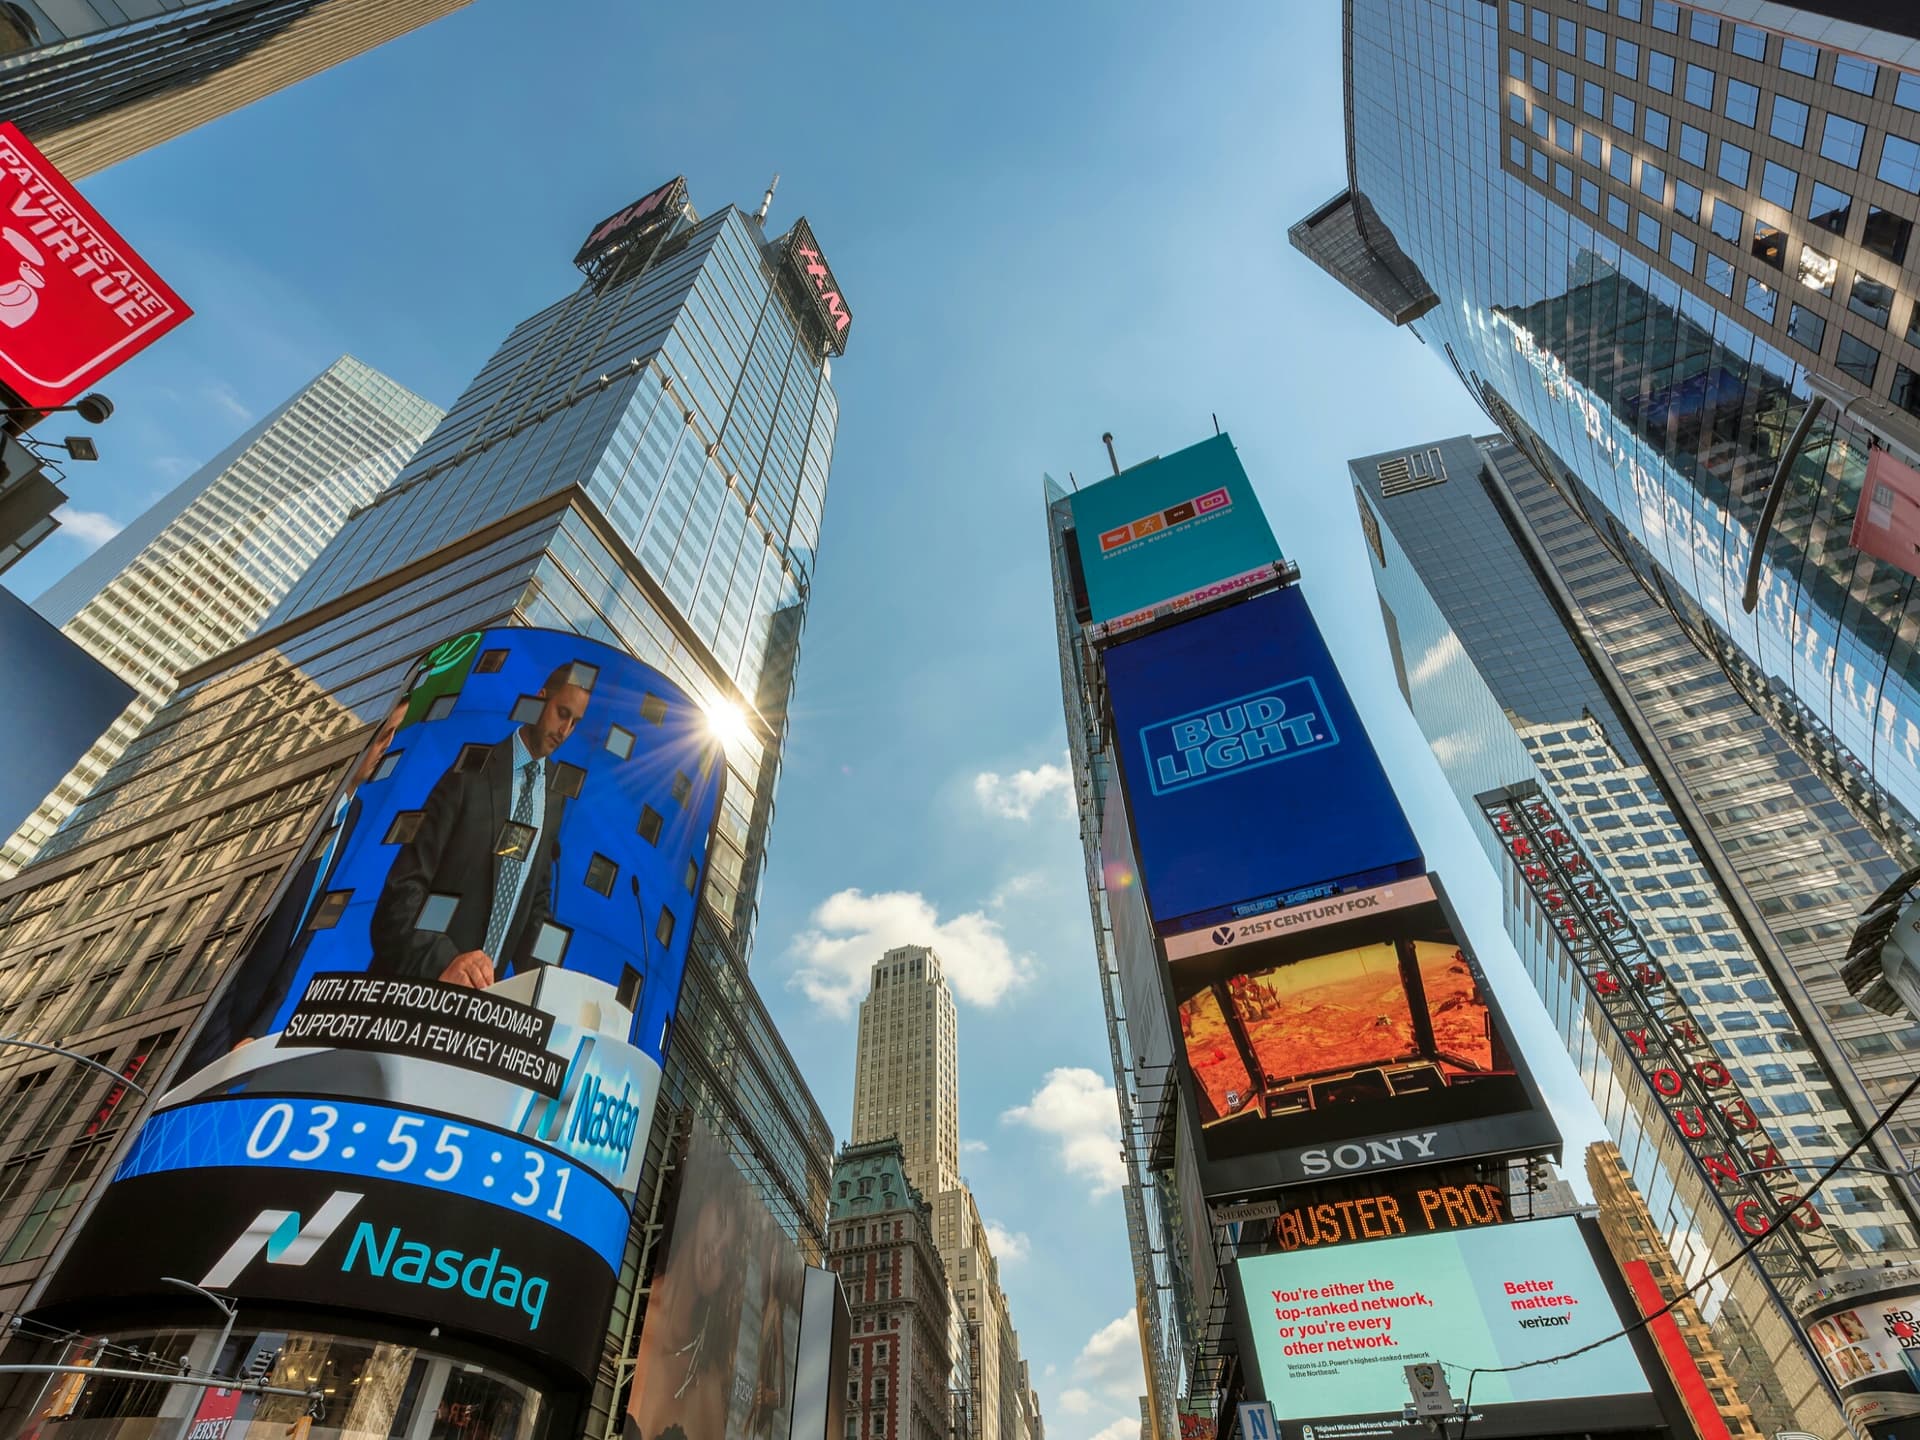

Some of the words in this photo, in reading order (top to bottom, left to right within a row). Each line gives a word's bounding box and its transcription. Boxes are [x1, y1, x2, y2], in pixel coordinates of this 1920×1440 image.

[0, 149, 115, 266] PATIENTS
[111, 269, 163, 314] ARE
[9, 190, 149, 327] VIRTUE
[1194, 570, 1268, 602] DONUTS
[1171, 696, 1286, 751] BUD
[1239, 919, 1273, 937] 21ST
[1274, 903, 1346, 929] CENTURY
[1347, 895, 1379, 912] FOX
[304, 979, 347, 1000] WITH
[348, 979, 385, 1002] THE
[381, 983, 468, 1017] PRODUCT
[465, 998, 543, 1045] ROADMAP,
[285, 1014, 371, 1038] SUPPORT
[366, 1017, 409, 1042] AND
[405, 1023, 422, 1046] A
[423, 1025, 465, 1054] FEW
[463, 1034, 500, 1064] KEY
[498, 1045, 543, 1081] HIRES
[544, 1061, 562, 1087] IN
[568, 1073, 641, 1174] Nasdaq
[1626, 1028, 1770, 1236] YOUNG
[1300, 1132, 1438, 1176] SONY
[340, 1221, 549, 1331] Nasdaq
[1272, 1288, 1318, 1303] You're
[1321, 1282, 1364, 1298] either
[1367, 1279, 1395, 1291] the
[1504, 1280, 1554, 1295] Better
[1275, 1299, 1358, 1321] top-ranked
[1361, 1292, 1433, 1311] network,
[1511, 1294, 1578, 1310] matters.
[1279, 1326, 1295, 1338] or
[1298, 1321, 1345, 1339] you're
[1348, 1316, 1391, 1330] every
[1518, 1315, 1569, 1329] verizon
[1882, 1310, 1913, 1326] RED
[1283, 1341, 1323, 1356] other
[1327, 1333, 1398, 1351] network.
[1287, 1362, 1311, 1371] Verizon
[1317, 1360, 1329, 1368] J.D.
[1329, 1358, 1354, 1367] Power's
[1354, 1354, 1402, 1366] highest-ranked
[1403, 1351, 1430, 1361] network
[1294, 1370, 1306, 1378] the
[1855, 1401, 1879, 1416] SHARP
[188, 1419, 232, 1440] JERSEY
[1247, 1409, 1268, 1440] N
